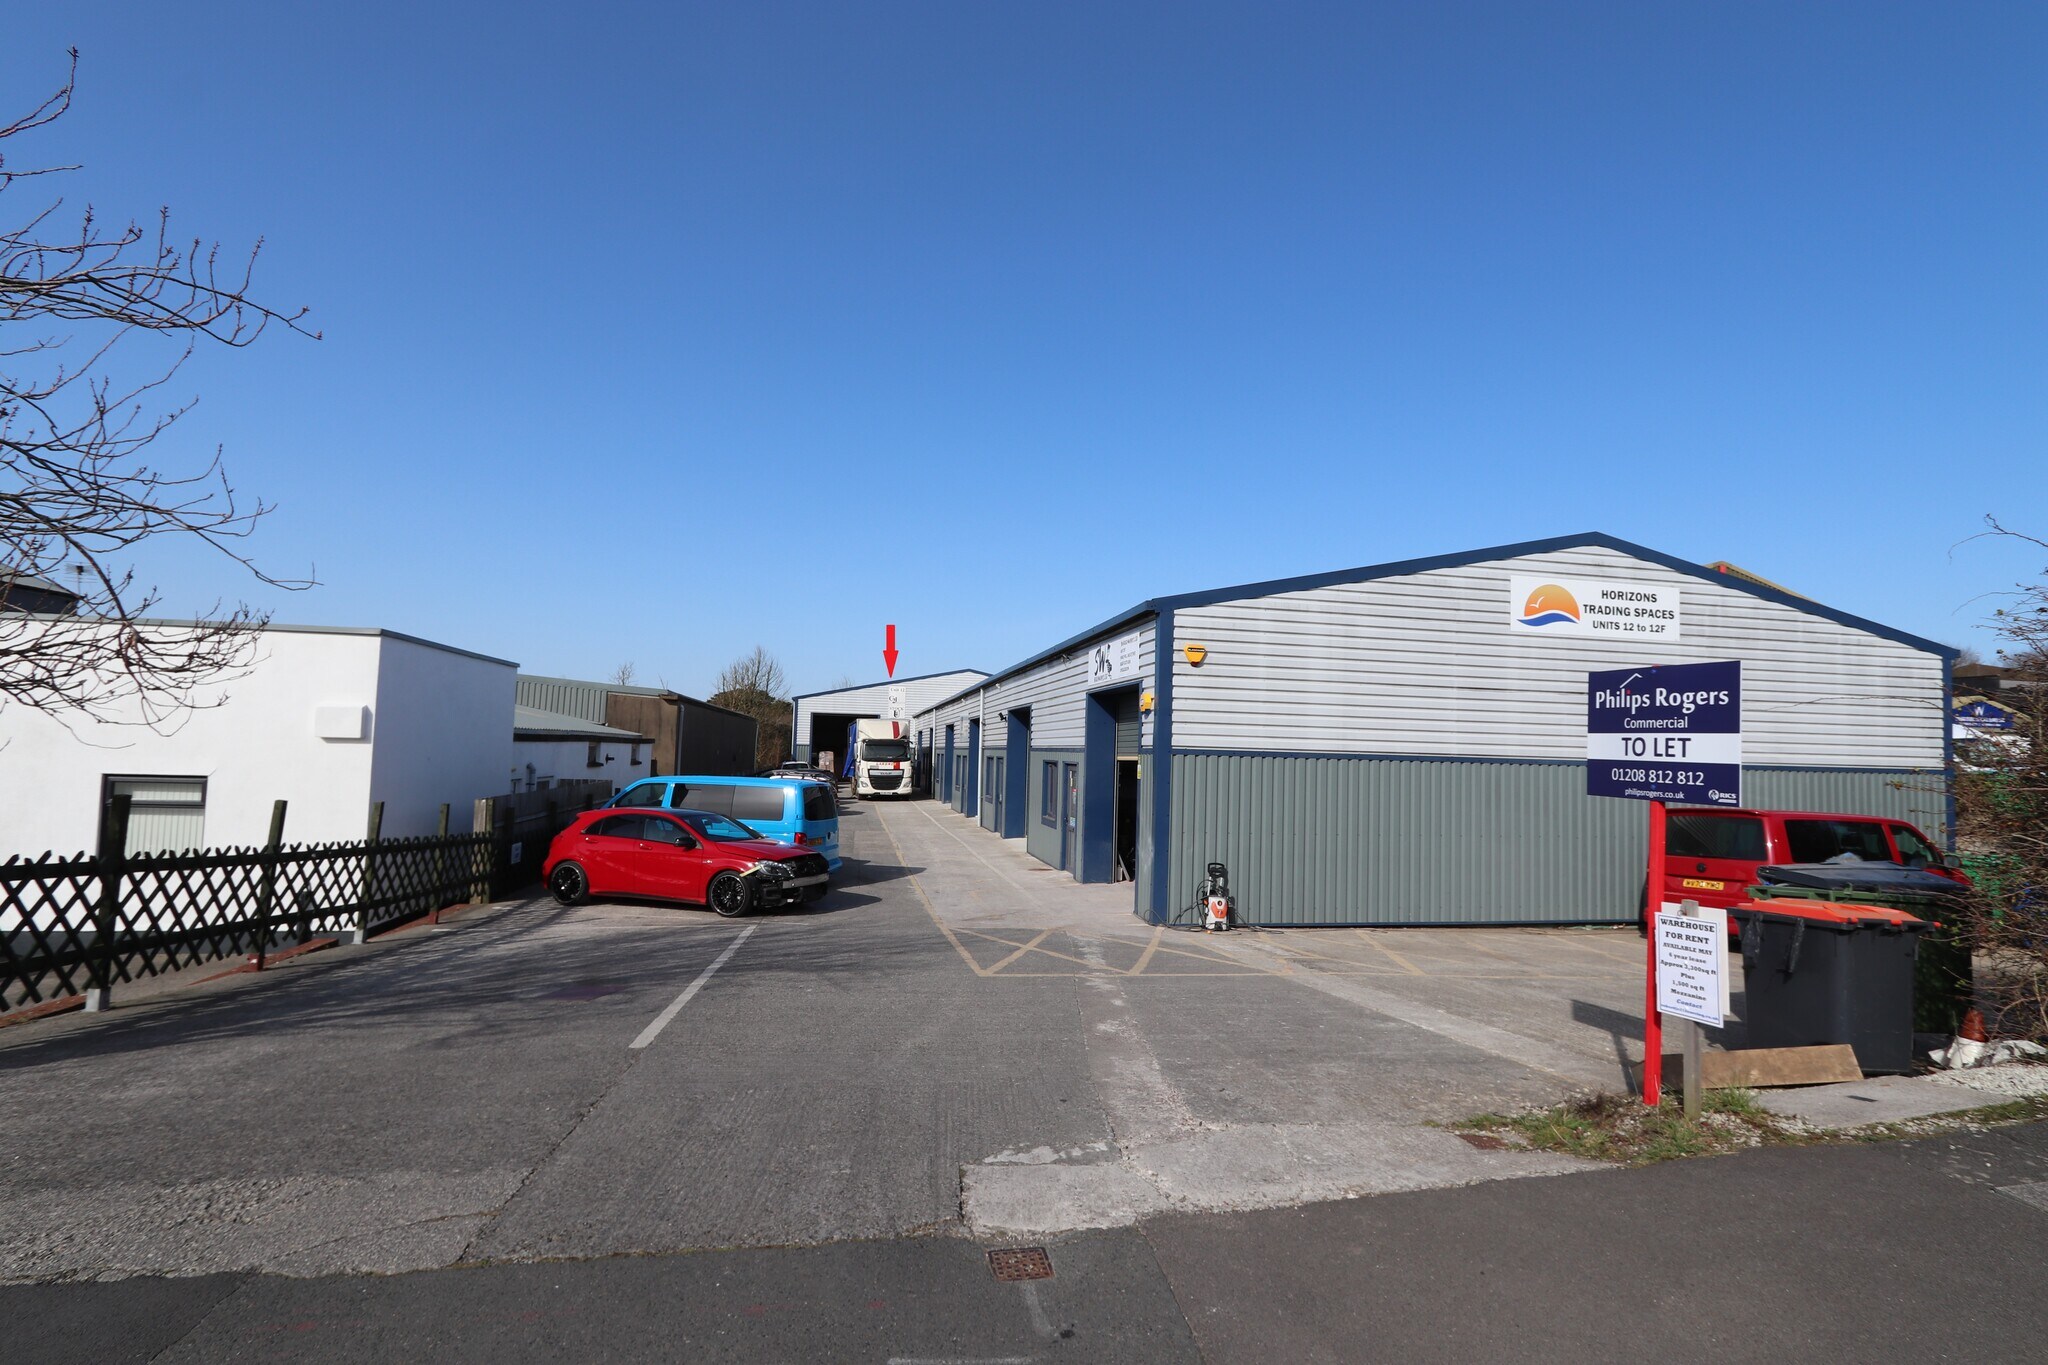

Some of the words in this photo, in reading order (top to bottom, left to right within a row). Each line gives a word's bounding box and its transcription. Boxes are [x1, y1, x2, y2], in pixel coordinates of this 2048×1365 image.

[1602, 590, 1657, 603] HORIZONS
[1583, 604, 1631, 617] TRADING
[1634, 608, 1675, 620] SPACES
[1592, 620, 1620, 630] UNITS
[1623, 622, 1633, 632] 12
[1637, 624, 1646, 632] to
[1650, 624, 1666, 633] 12F
[1595, 688, 1650, 714] Philips
[1656, 688, 1729, 714] Rogers
[1624, 716, 1688, 728] Commercial
[1621, 737, 1646, 756] TO
[1654, 738, 1691, 758] LET
[1612, 768, 1645, 782] 01208
[1648, 769, 1673, 783] 812
[1677, 771, 1704, 786] 812
[1624, 788, 1685, 799] philipsrogers.co.uk
[1660, 918, 1715, 933] WAREHOUSE
[1665, 931, 1684, 941] FOR
[1685, 935, 1710, 945] RENT
[1662, 942, 1696, 953] AVAILABLE
[1698, 948, 1712, 956] MAY
[1689, 956, 1707, 964] lease
[1670, 988, 1707, 1001] Mezzanine
[1676, 999, 1702, 1009] Contact
